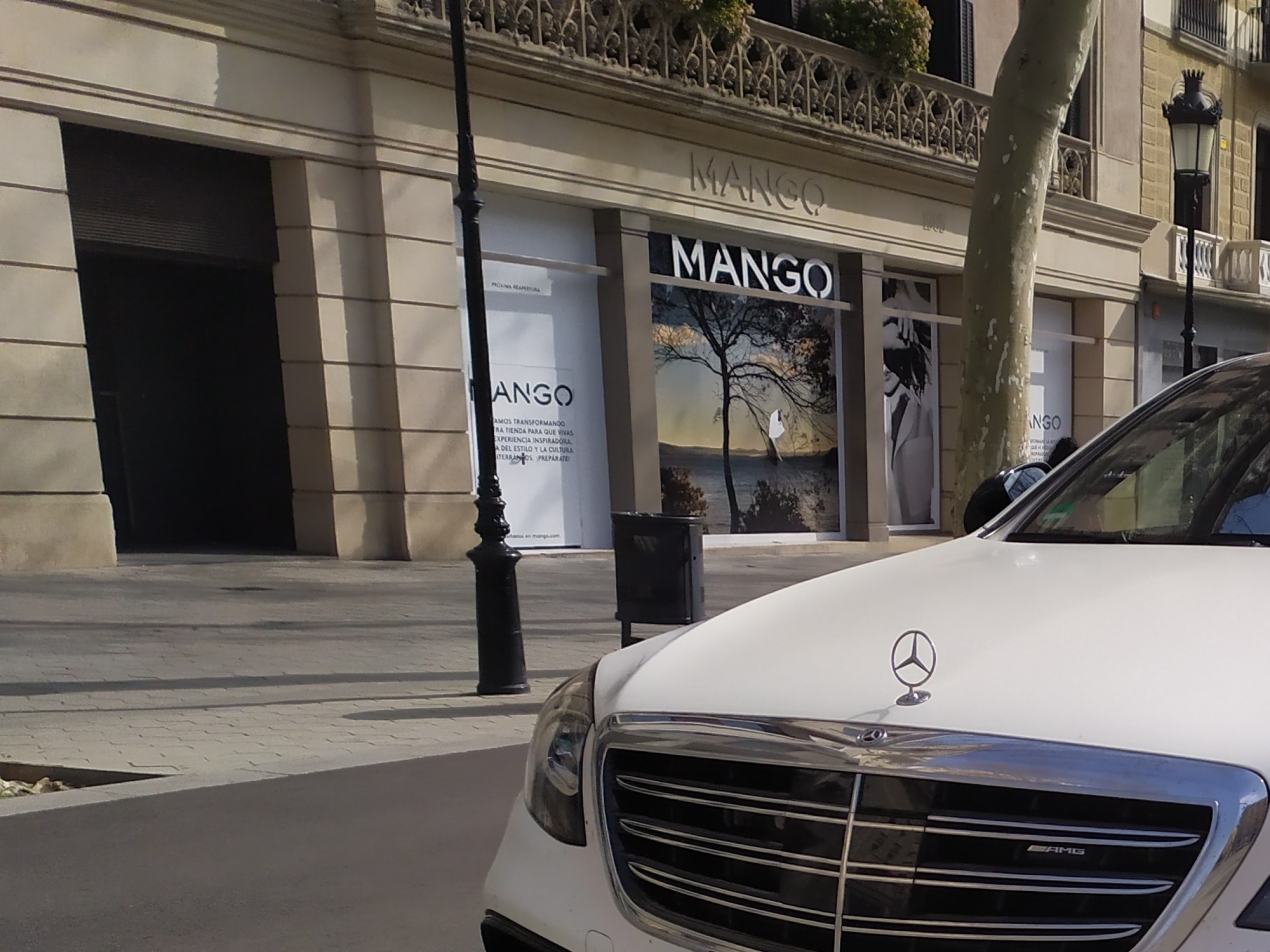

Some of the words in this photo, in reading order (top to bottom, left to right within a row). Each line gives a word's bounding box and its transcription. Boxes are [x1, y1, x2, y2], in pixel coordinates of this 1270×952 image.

[690, 152, 825, 216] MANGO
[671, 233, 833, 299] MANGO
[513, 418, 566, 427] TRANSFORMANDO
[1029, 414, 1062, 431] NGO
[558, 429, 574, 437] VIVAS
[1045, 846, 1086, 856] AMG
